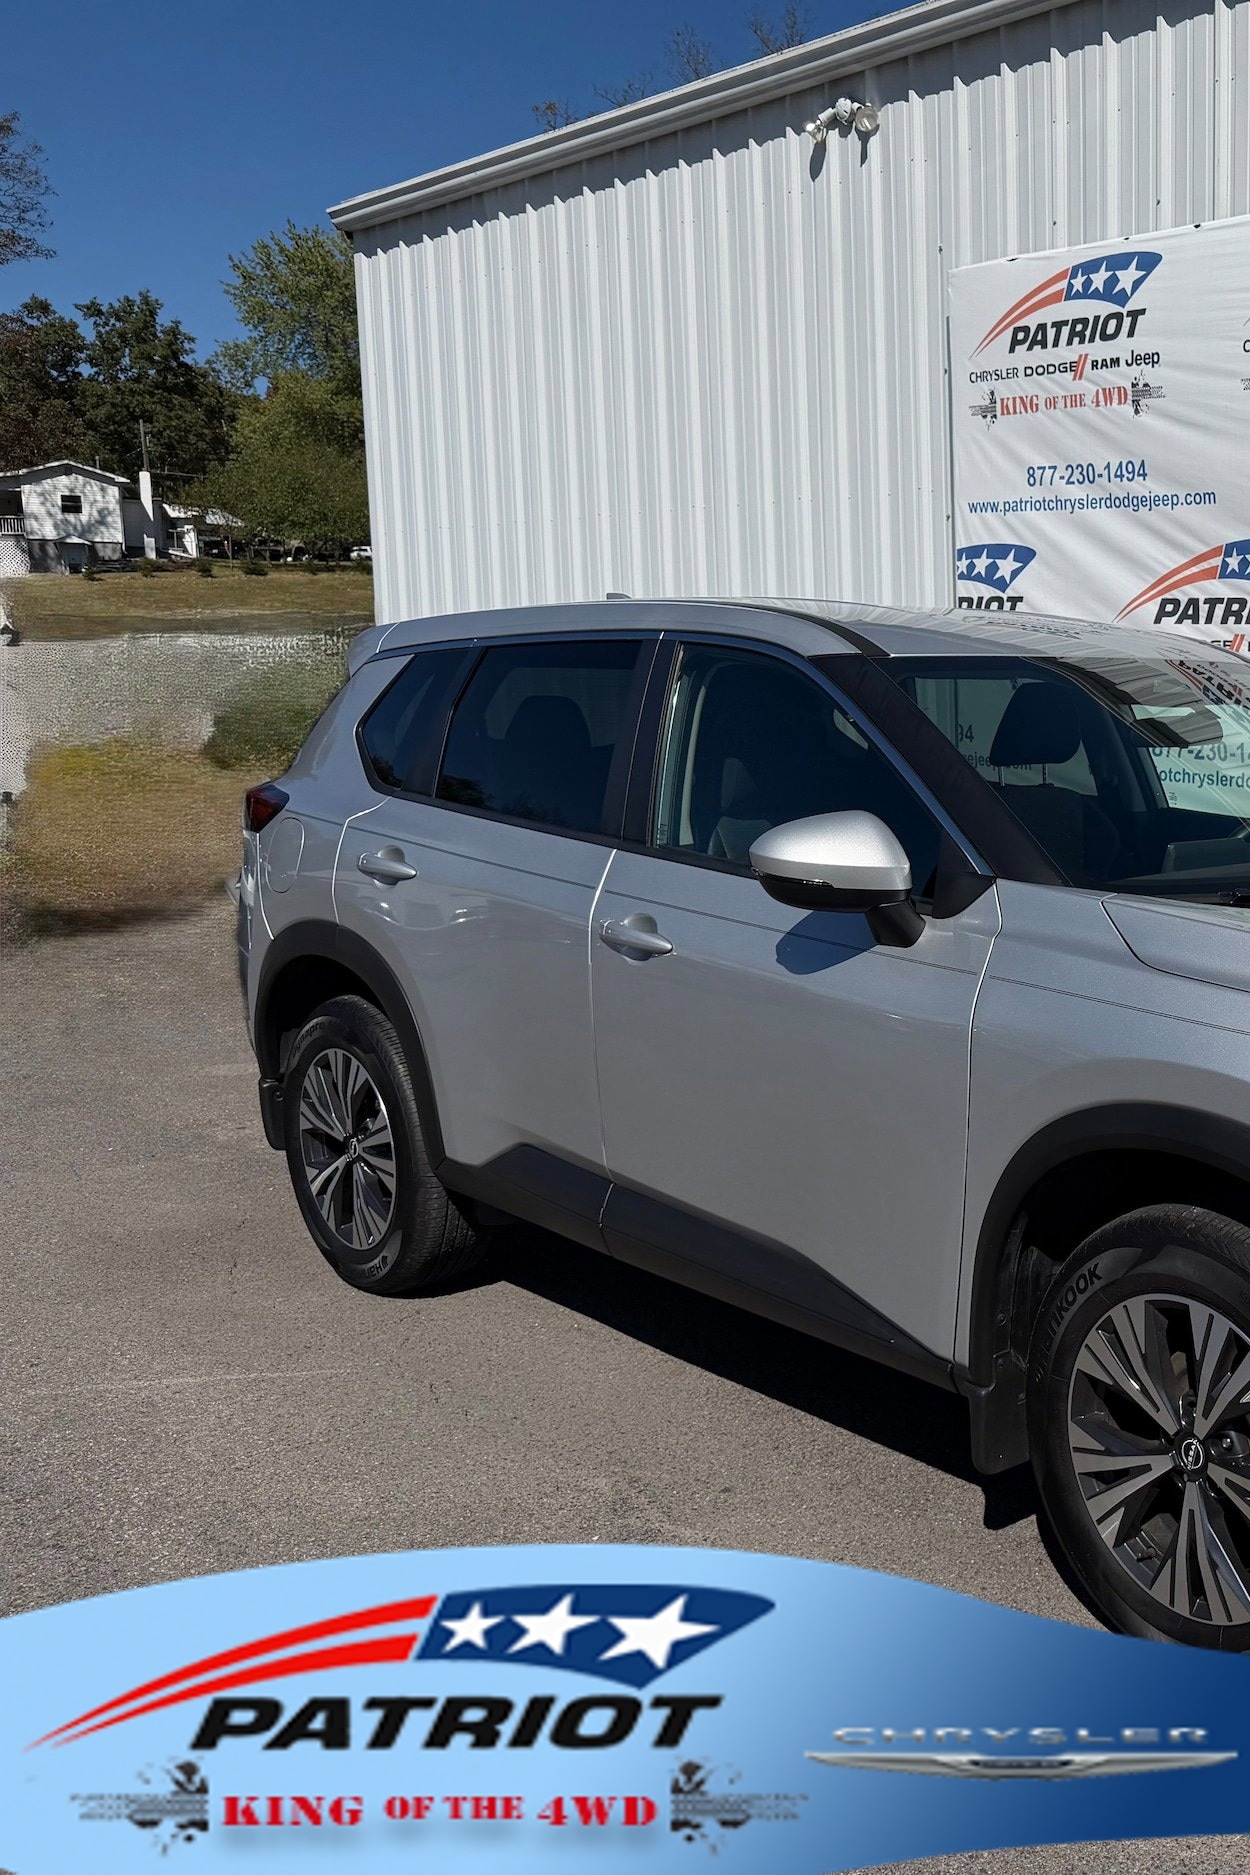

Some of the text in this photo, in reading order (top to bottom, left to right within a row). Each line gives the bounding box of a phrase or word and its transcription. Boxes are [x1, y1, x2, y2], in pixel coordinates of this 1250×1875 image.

[1009, 307, 1146, 354] PATRIOT
[969, 349, 1161, 384] CHRYSLER DODGE RAM Jeep
[999, 385, 1128, 417] KING OF THE 4WD
[1027, 459, 1148, 486] 877-230-1494
[970, 492, 1216, 513] www.patriotchryslerdodgejeep.com
